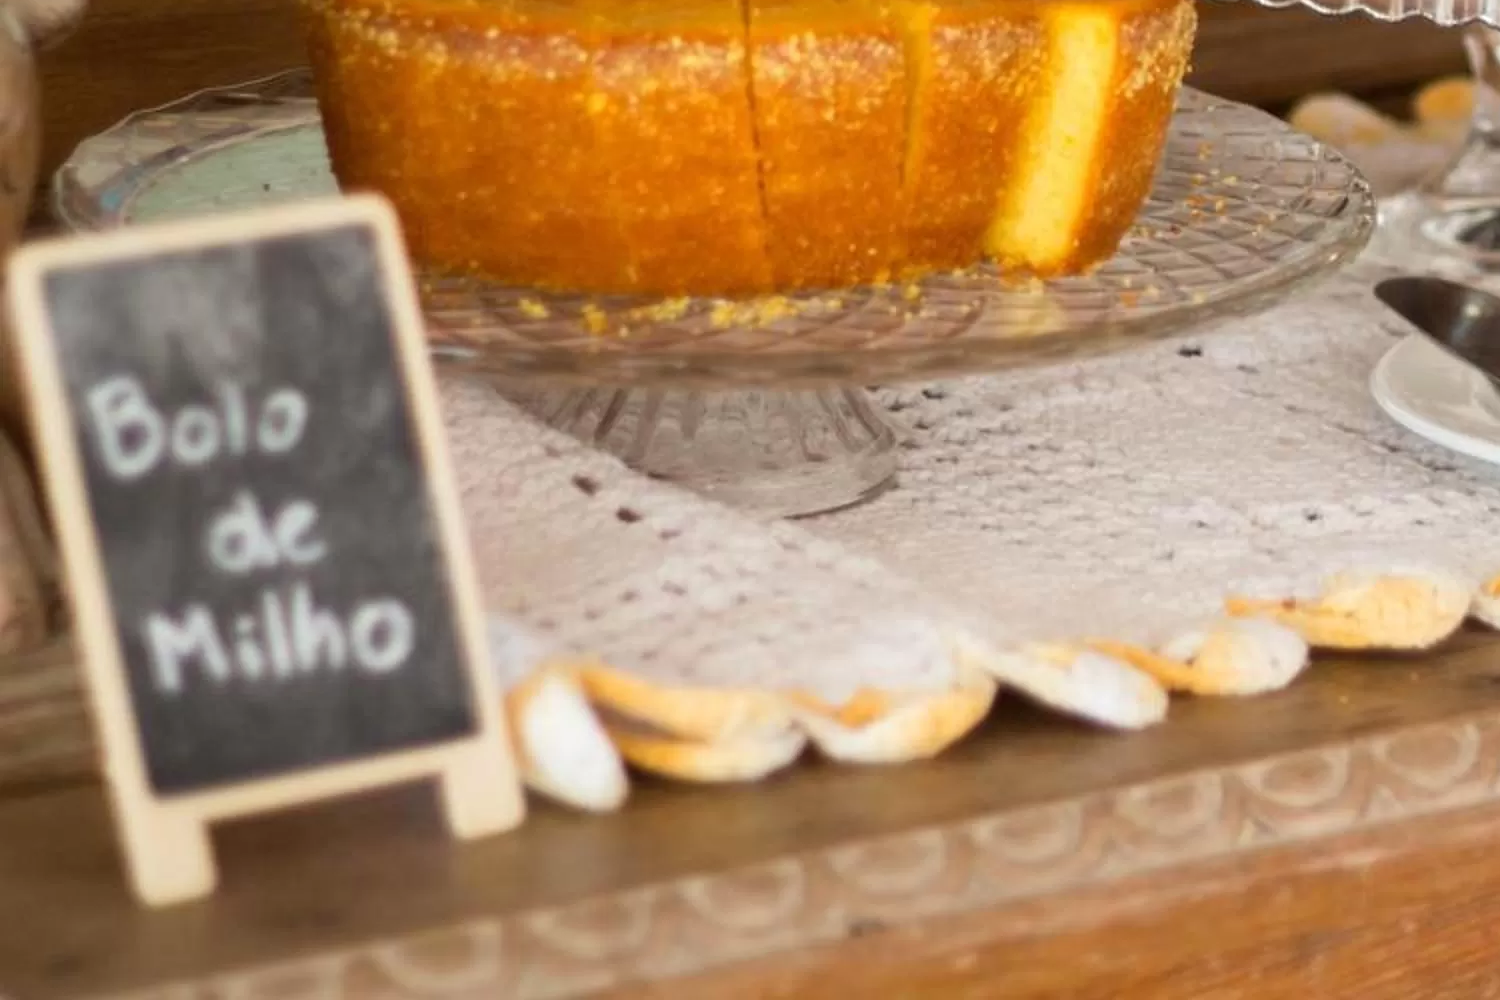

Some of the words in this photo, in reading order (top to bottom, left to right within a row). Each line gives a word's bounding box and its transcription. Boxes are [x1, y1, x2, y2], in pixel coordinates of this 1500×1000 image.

[86, 374, 309, 480] Bolo
[208, 490, 327, 574] de
[142, 585, 415, 693] Milho
